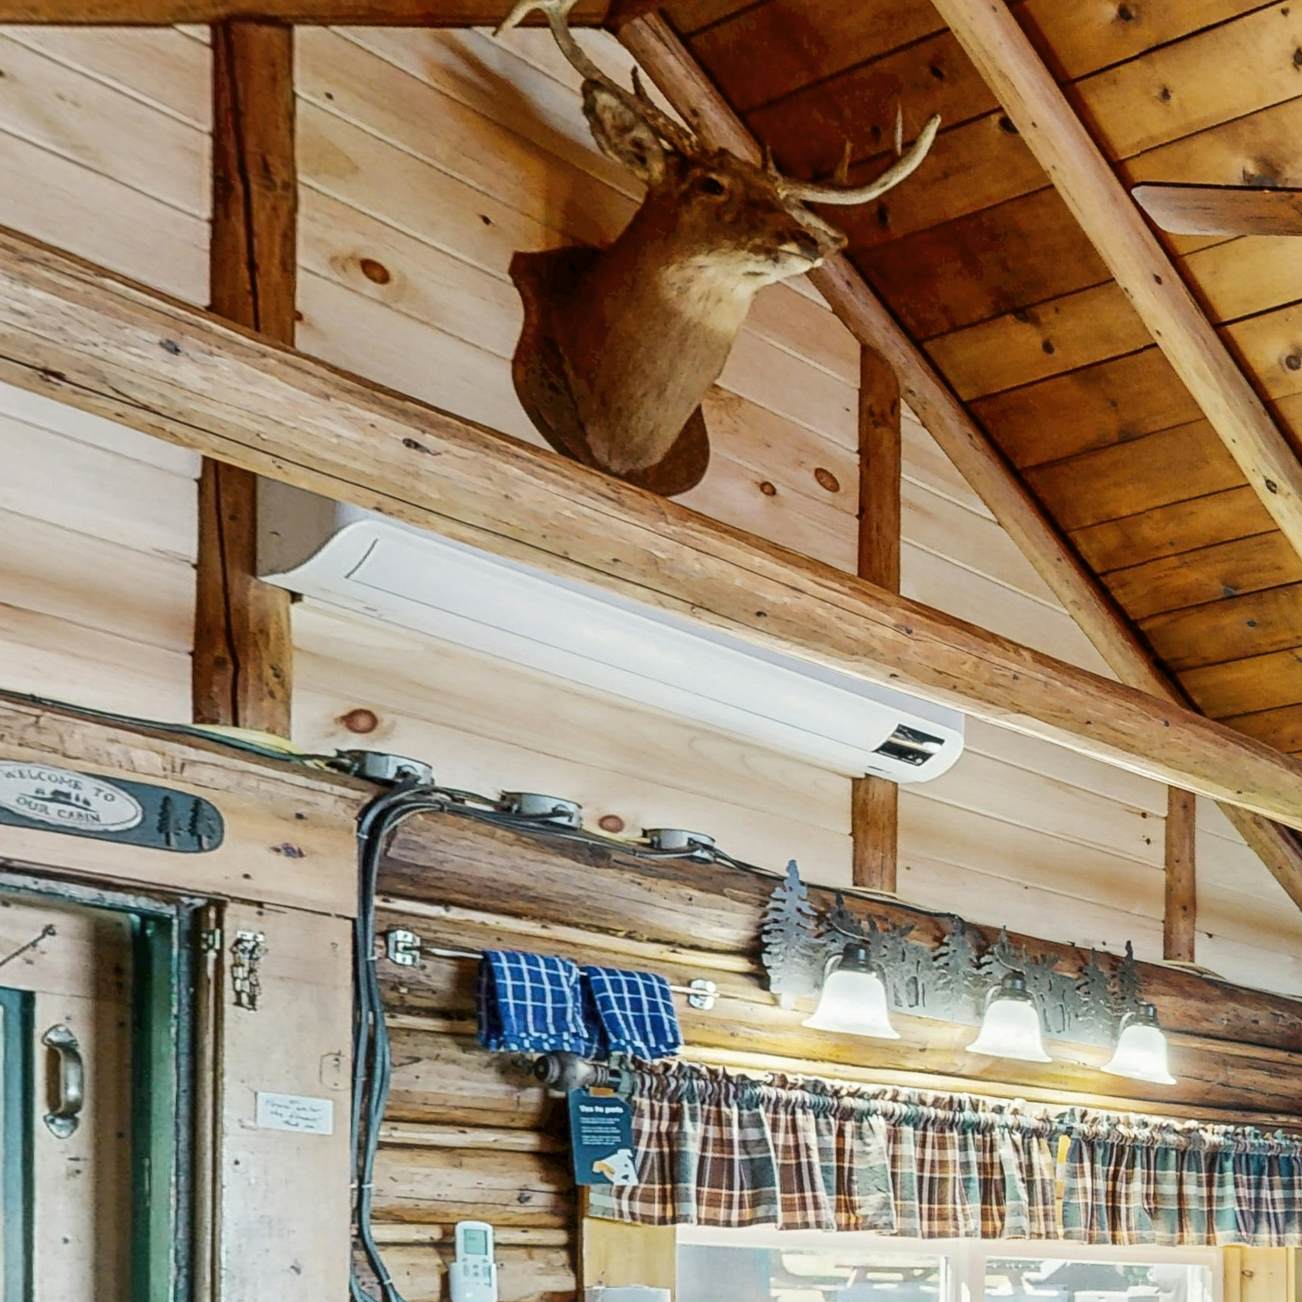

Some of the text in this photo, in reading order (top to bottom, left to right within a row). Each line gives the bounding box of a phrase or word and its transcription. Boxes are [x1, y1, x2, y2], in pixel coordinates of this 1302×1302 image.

[1, 768, 116, 802] WELCOME TO
[16, 796, 101, 823] OUR CABIN
